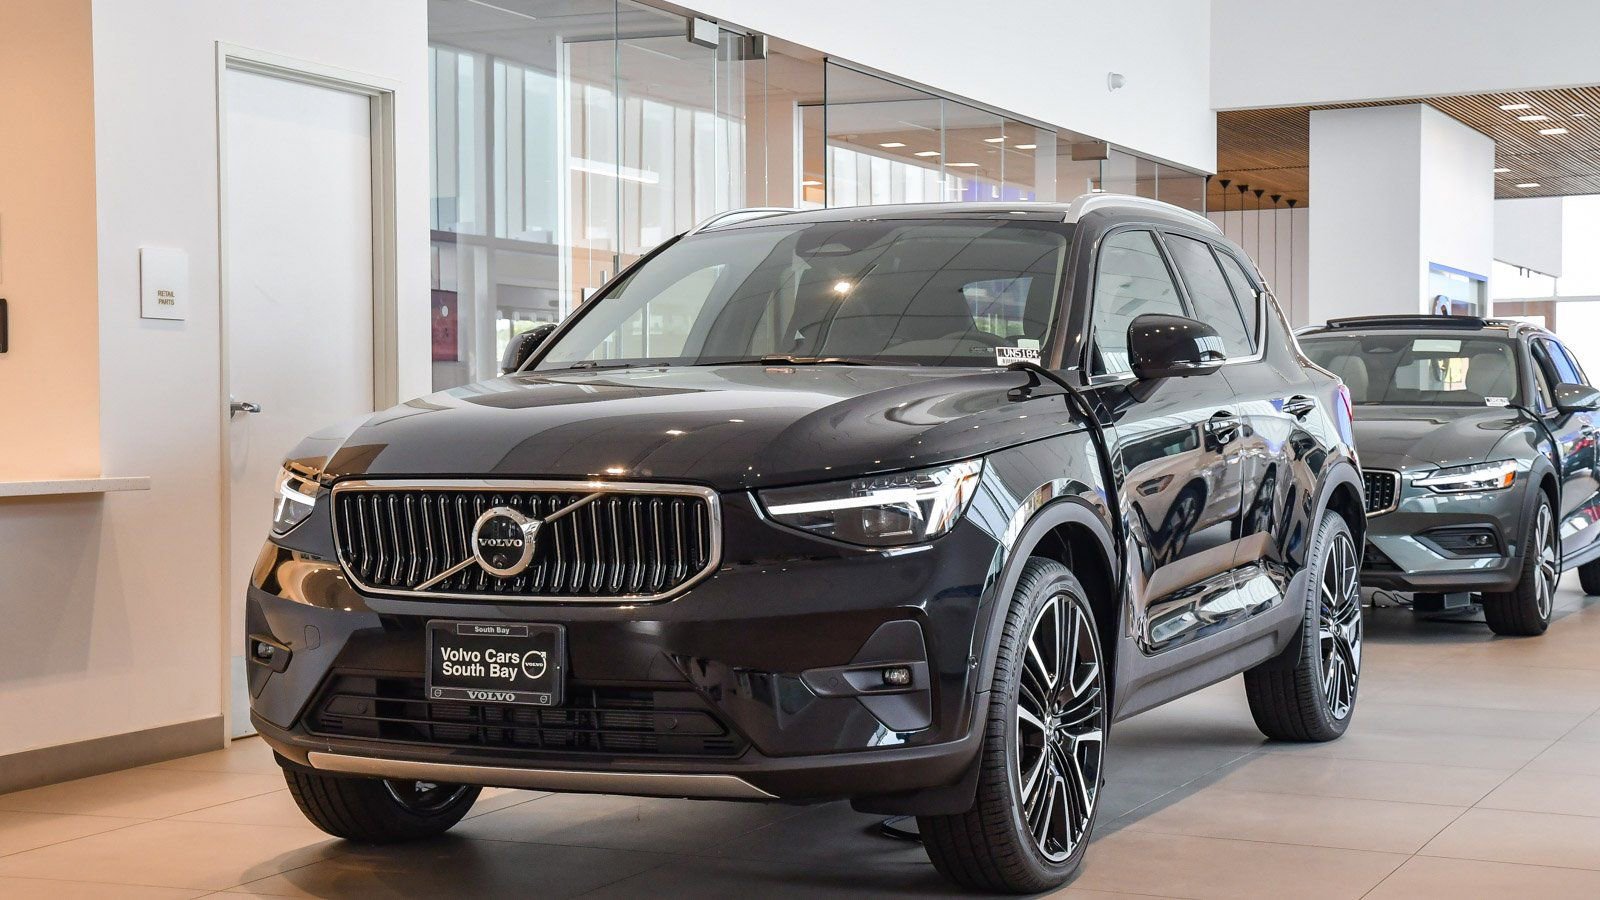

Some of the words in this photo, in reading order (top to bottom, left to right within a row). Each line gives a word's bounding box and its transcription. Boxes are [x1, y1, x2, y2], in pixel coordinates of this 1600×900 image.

[478, 538, 523, 547] VOLVO
[496, 626, 510, 635] Bay
[440, 647, 481, 662] Volvo
[485, 649, 520, 664] Cars
[442, 662, 485, 677] South
[490, 664, 518, 681] Bay
[467, 690, 516, 702] VOLVO
